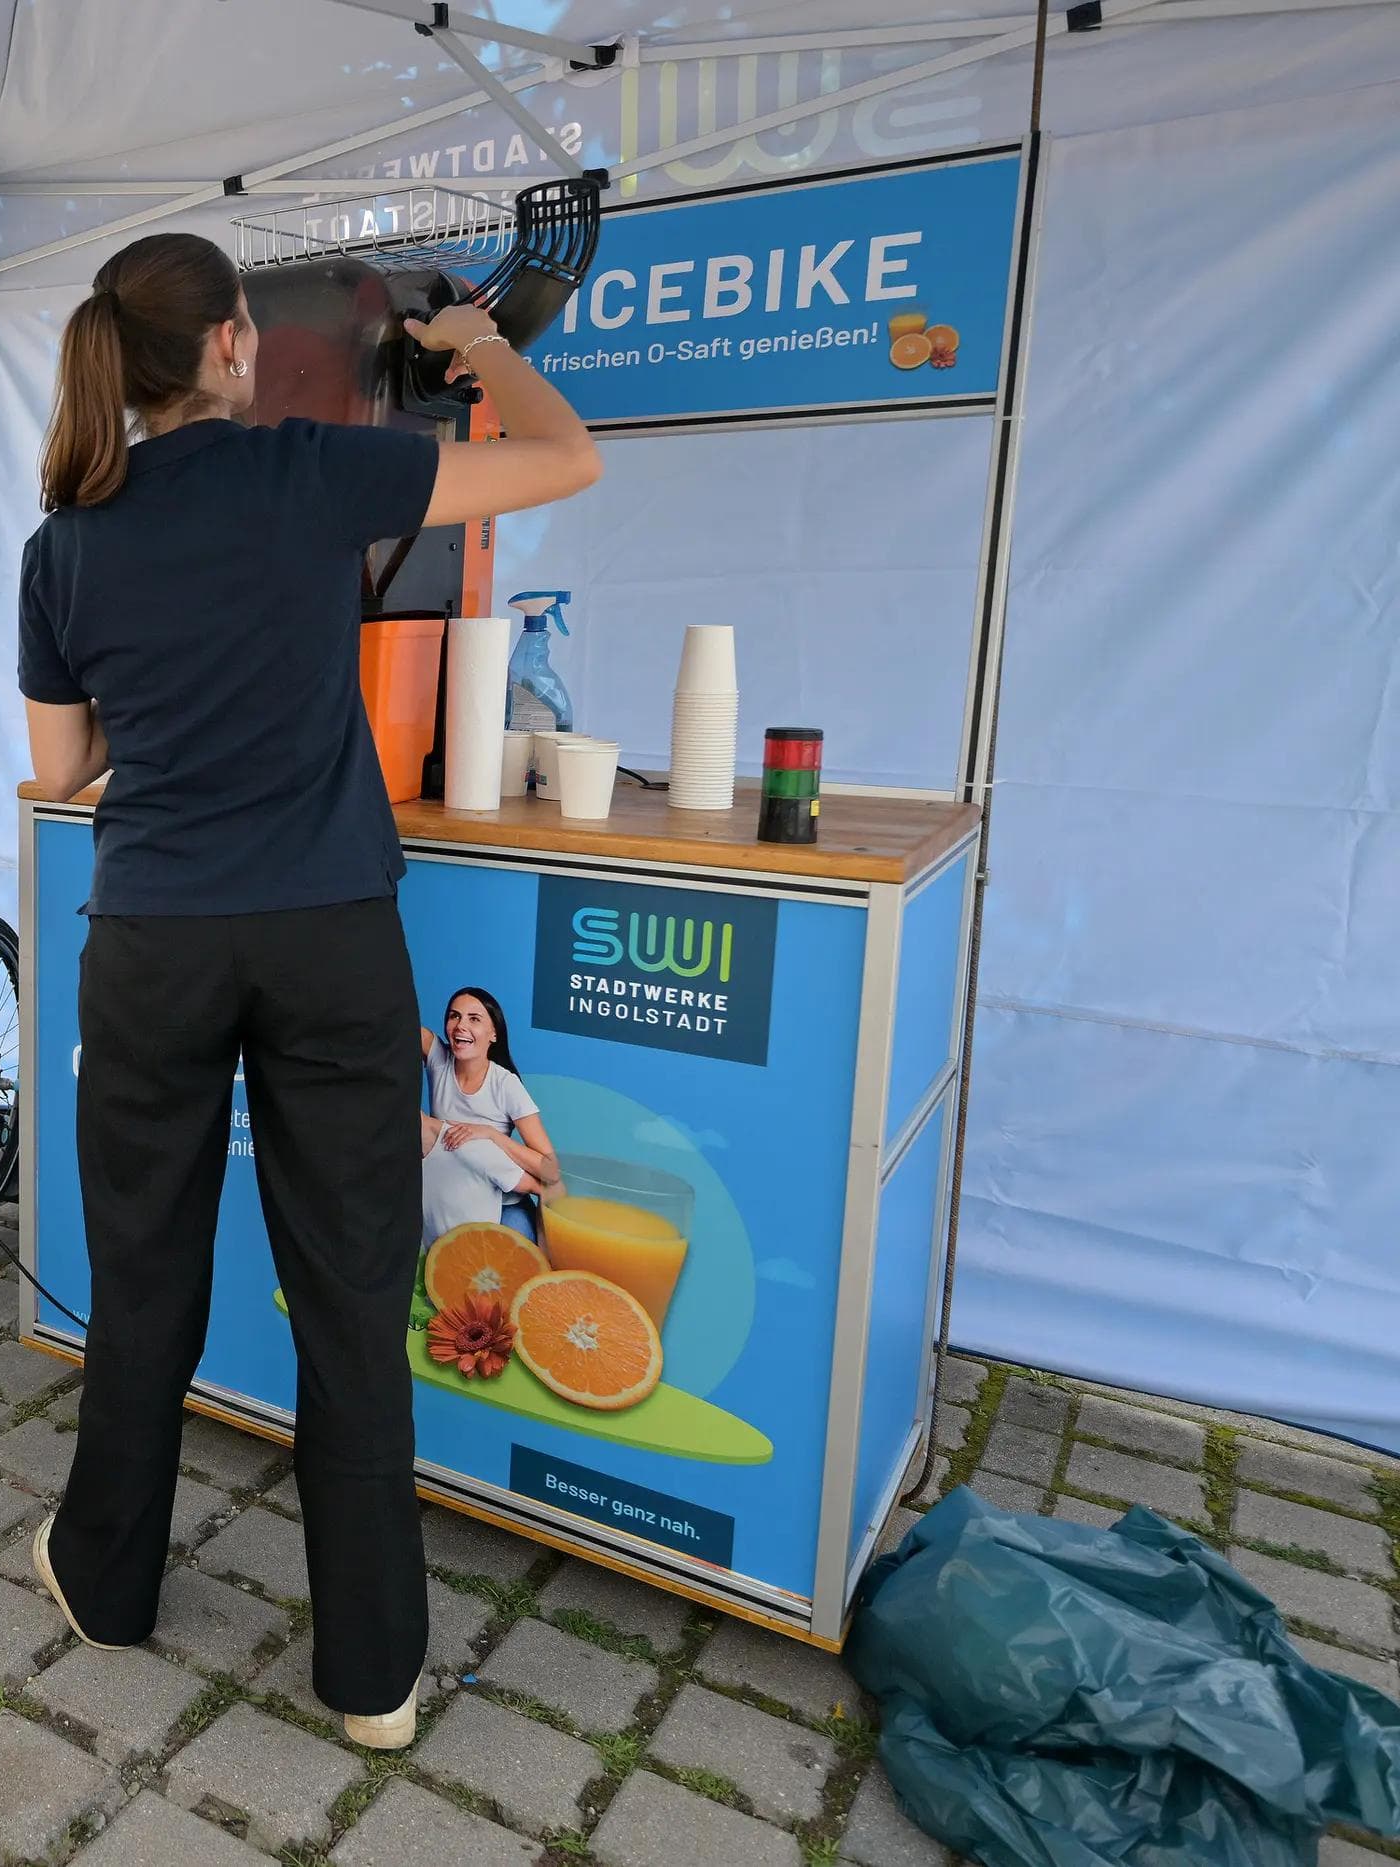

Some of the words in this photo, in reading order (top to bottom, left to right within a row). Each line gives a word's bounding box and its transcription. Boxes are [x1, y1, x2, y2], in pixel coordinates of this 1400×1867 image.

[543, 349, 640, 373] frischen
[647, 335, 731, 364] O-Saft
[739, 322, 879, 360] genießen!
[572, 907, 733, 983] SWI
[569, 996, 728, 1034] INGOLSTADT
[570, 974, 728, 1011] STADTWERKE
[545, 1473, 608, 1507] Besser
[611, 1499, 656, 1525] ganz
[660, 1515, 701, 1540] nah.
